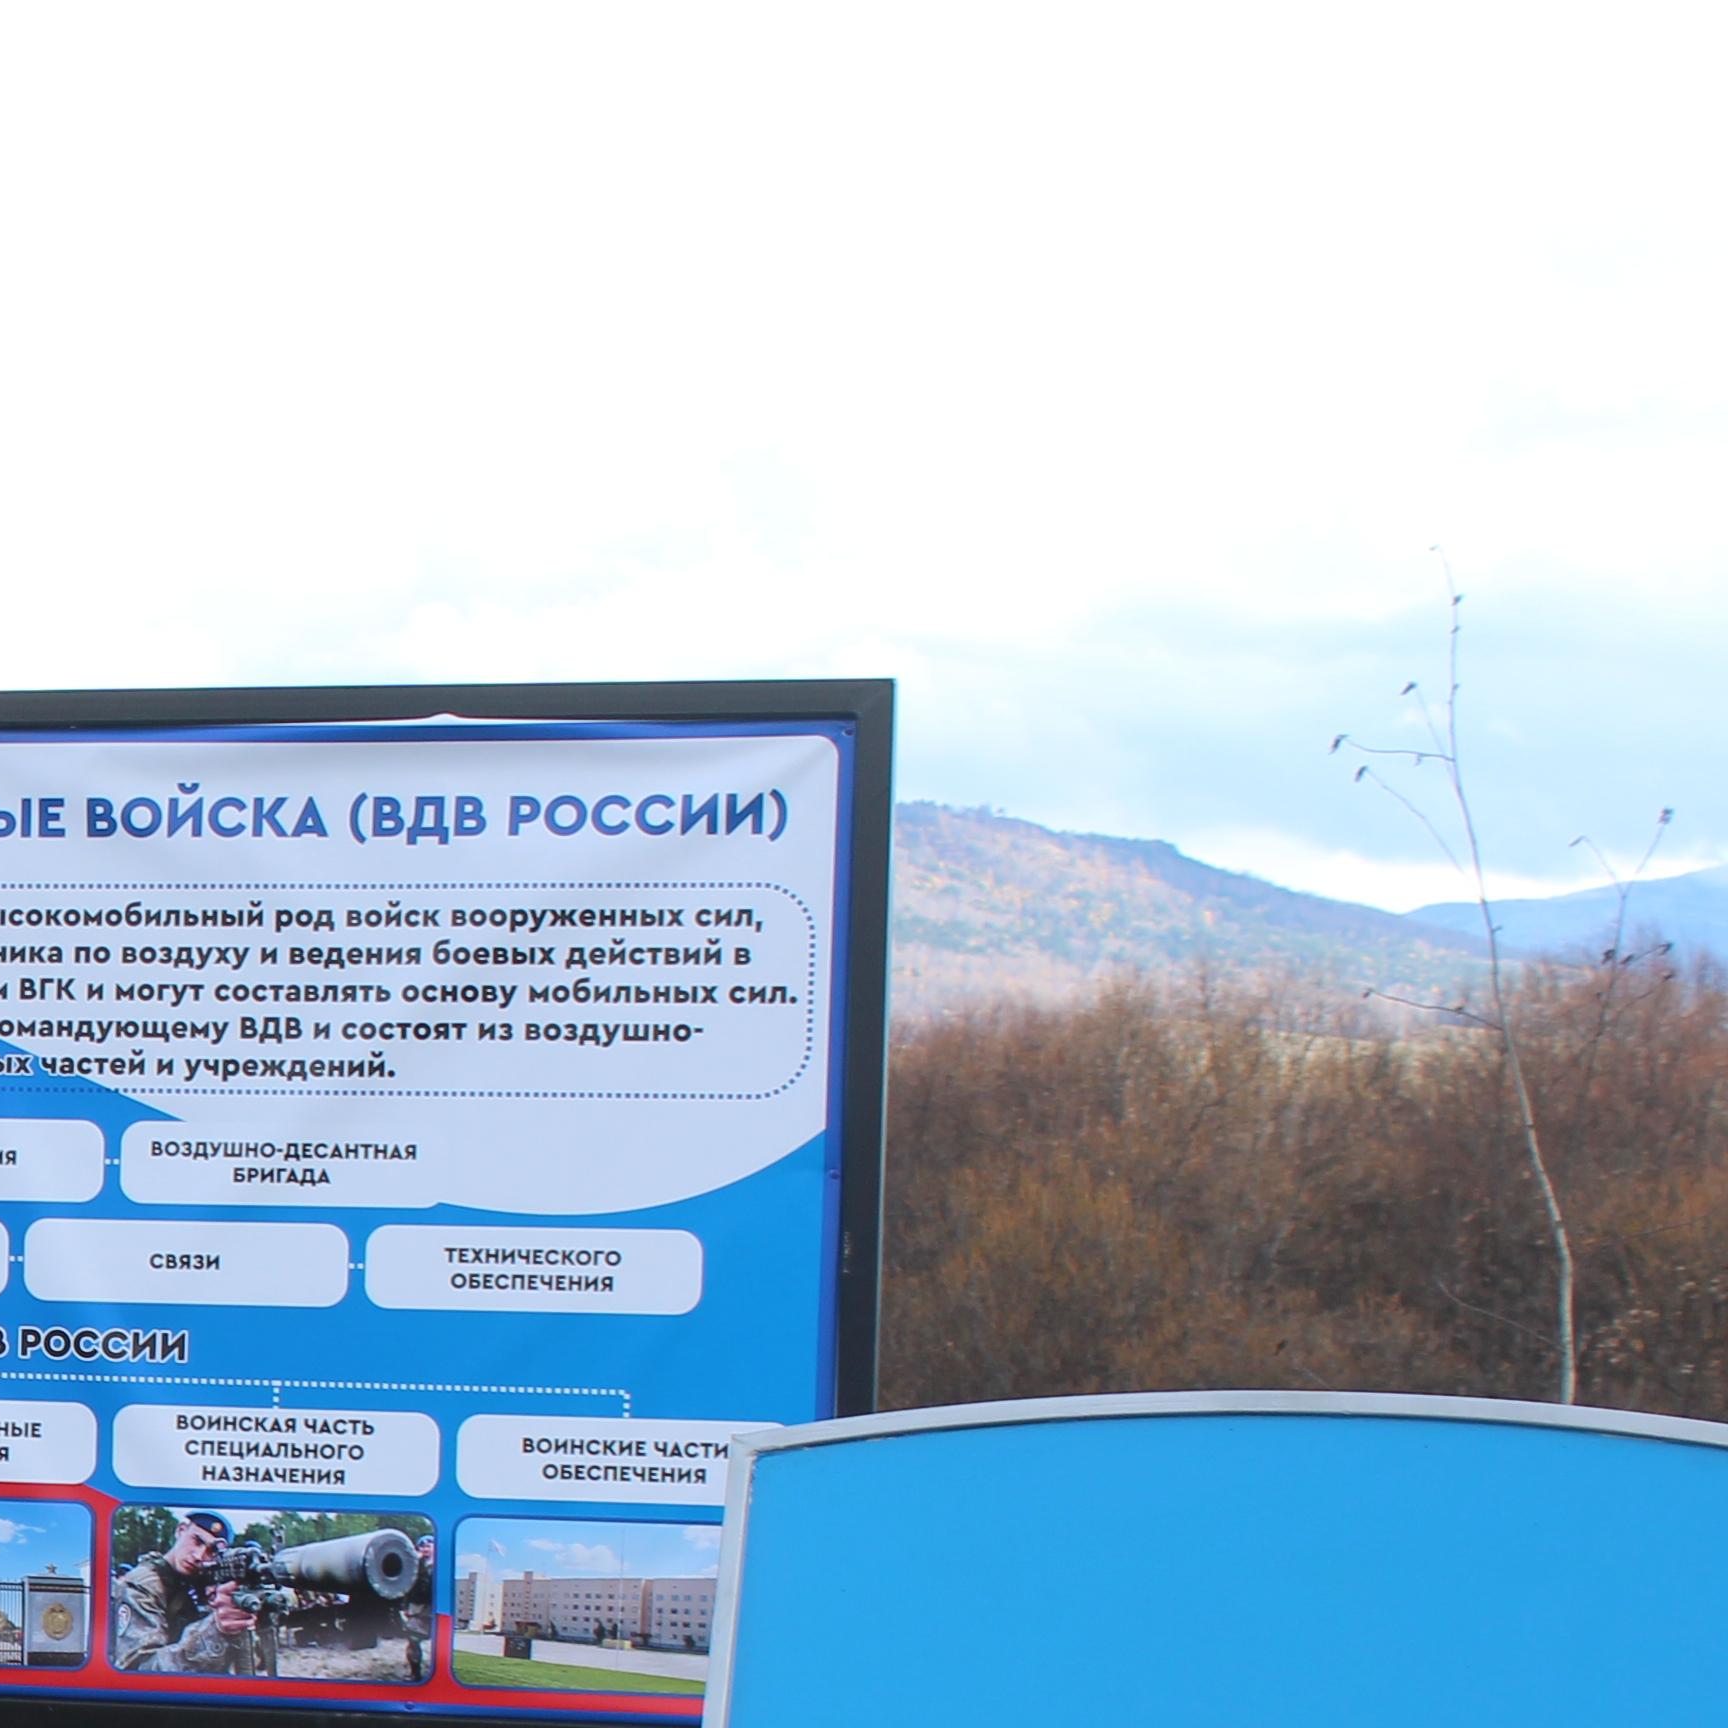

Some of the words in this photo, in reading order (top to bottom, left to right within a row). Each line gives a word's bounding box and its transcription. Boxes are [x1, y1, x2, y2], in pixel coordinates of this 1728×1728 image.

[86, 782, 329, 838] ВОЙСКА
[350, 792, 487, 845] (ВДВ
[510, 788, 788, 841] РОССИИ)
[275, 909, 334, 933] род
[346, 900, 439, 928] войск
[451, 909, 683, 933] вооруженных
[695, 909, 762, 933] сил,
[74, 946, 110, 964] по
[122, 946, 249, 971] воздуху
[260, 947, 277, 965] и
[289, 947, 421, 970] ведения
[433, 939, 554, 965] боевых
[565, 938, 721, 970] действий
[734, 947, 750, 966] в
[19, 978, 75, 1000] ВГК
[87, 983, 103, 1000] и
[115, 983, 204, 1008] могут
[214, 984, 390, 1002] составлять
[402, 984, 517, 1009] основу
[529, 977, 717, 1004] мобильных
[729, 985, 797, 1004] сил.
[240, 1016, 302, 1044] ВДВ
[314, 1022, 330, 1040] и
[341, 1022, 467, 1041] состоят
[478, 1023, 513, 1041] из
[525, 1023, 702, 1048] воздушно-
[41, 1049, 145, 1076] частей
[157, 1058, 173, 1076] и
[184, 1051, 395, 1082] учреждений.
[151, 1141, 416, 1161] ВОЗДУШНО-ДЕСАНТНАЯ
[233, 1167, 330, 1187] БРИГАДА
[150, 1253, 220, 1270] СВЯЗИ
[445, 1247, 621, 1266] ТЕХНИЧЕСКОГО
[450, 1273, 613, 1291] ОБЕСПЕЧЕНИЯ
[21, 1329, 185, 1361] РОССИИ
[176, 1414, 296, 1433] ВОИНСКАЯ
[304, 1418, 374, 1436] ЧАСТЬ
[185, 1439, 364, 1460] СПЕЦИАЛЬНОГО
[522, 1437, 645, 1457] ВОИНСКИЕ
[654, 1441, 728, 1459] ЧАСТИ
[202, 1466, 345, 1484] НАЗНАЧЕНИЯ
[542, 1463, 706, 1483] ОБЕСПЕЧЕНИЯ
